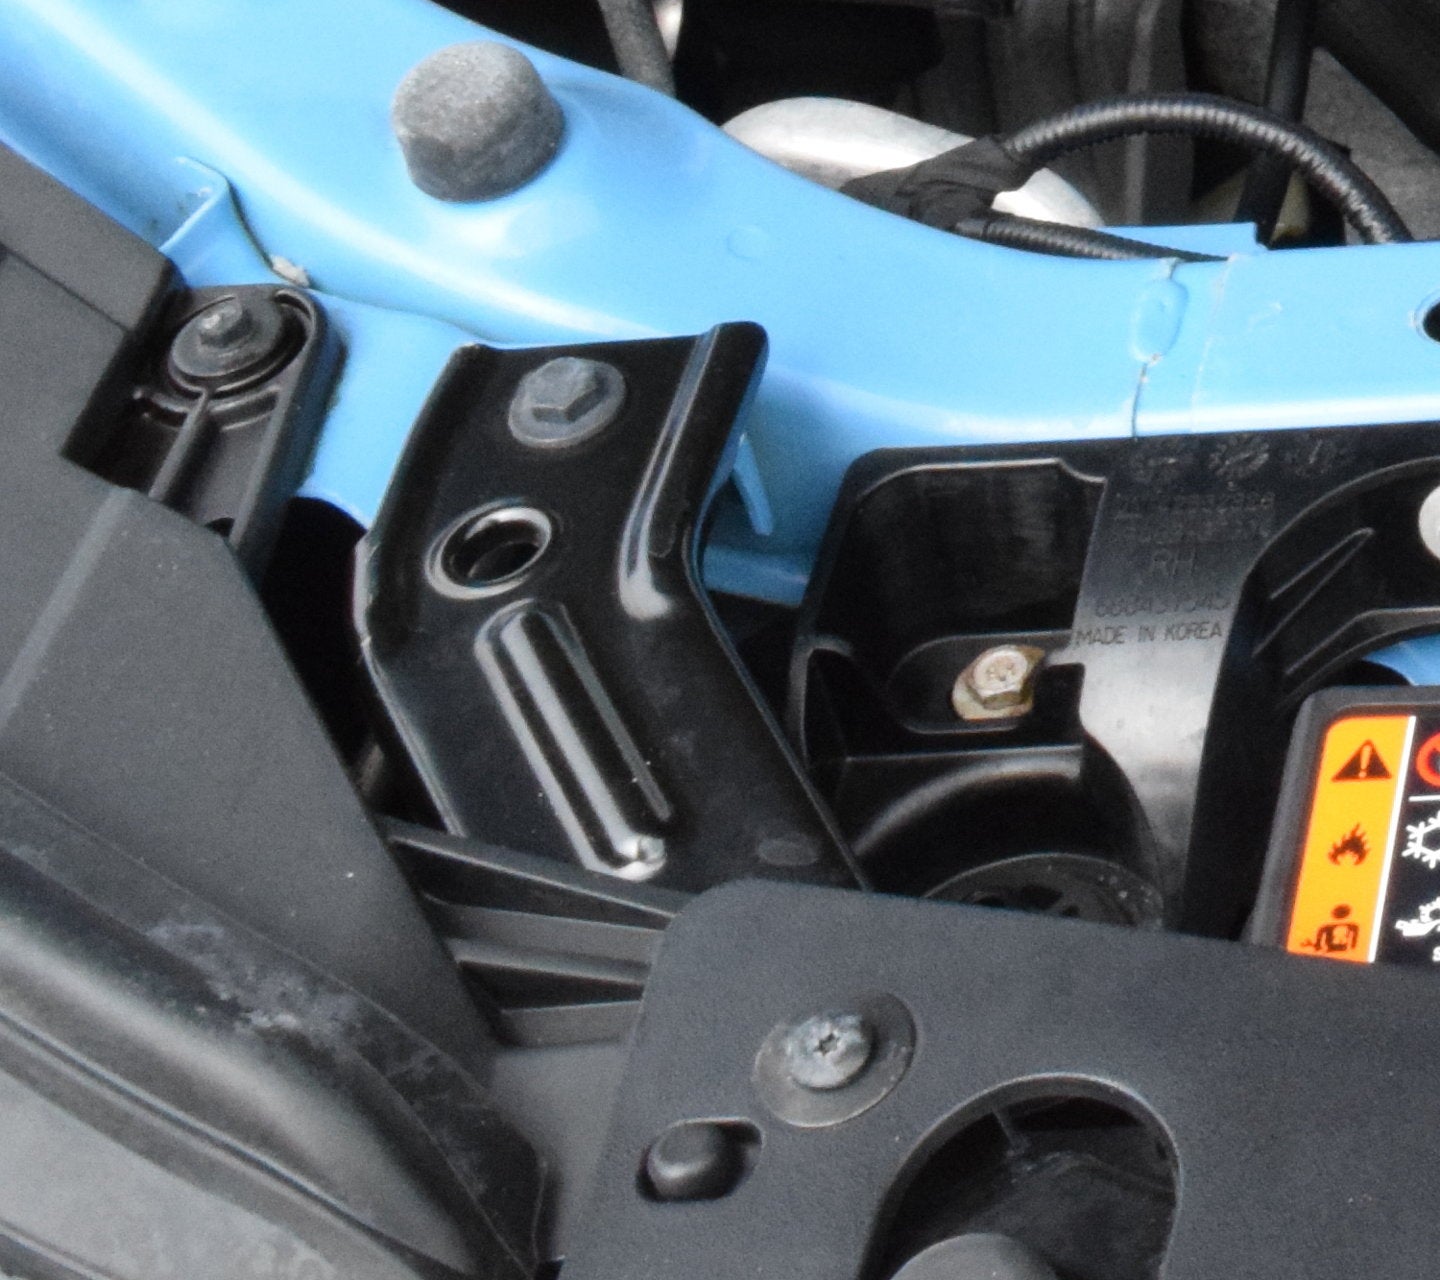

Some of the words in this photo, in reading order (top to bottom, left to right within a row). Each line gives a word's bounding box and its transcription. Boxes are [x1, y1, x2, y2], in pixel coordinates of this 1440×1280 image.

[1074, 624, 1127, 645] MADE
[1138, 624, 1156, 642] IN
[1165, 620, 1223, 641] KOREA
